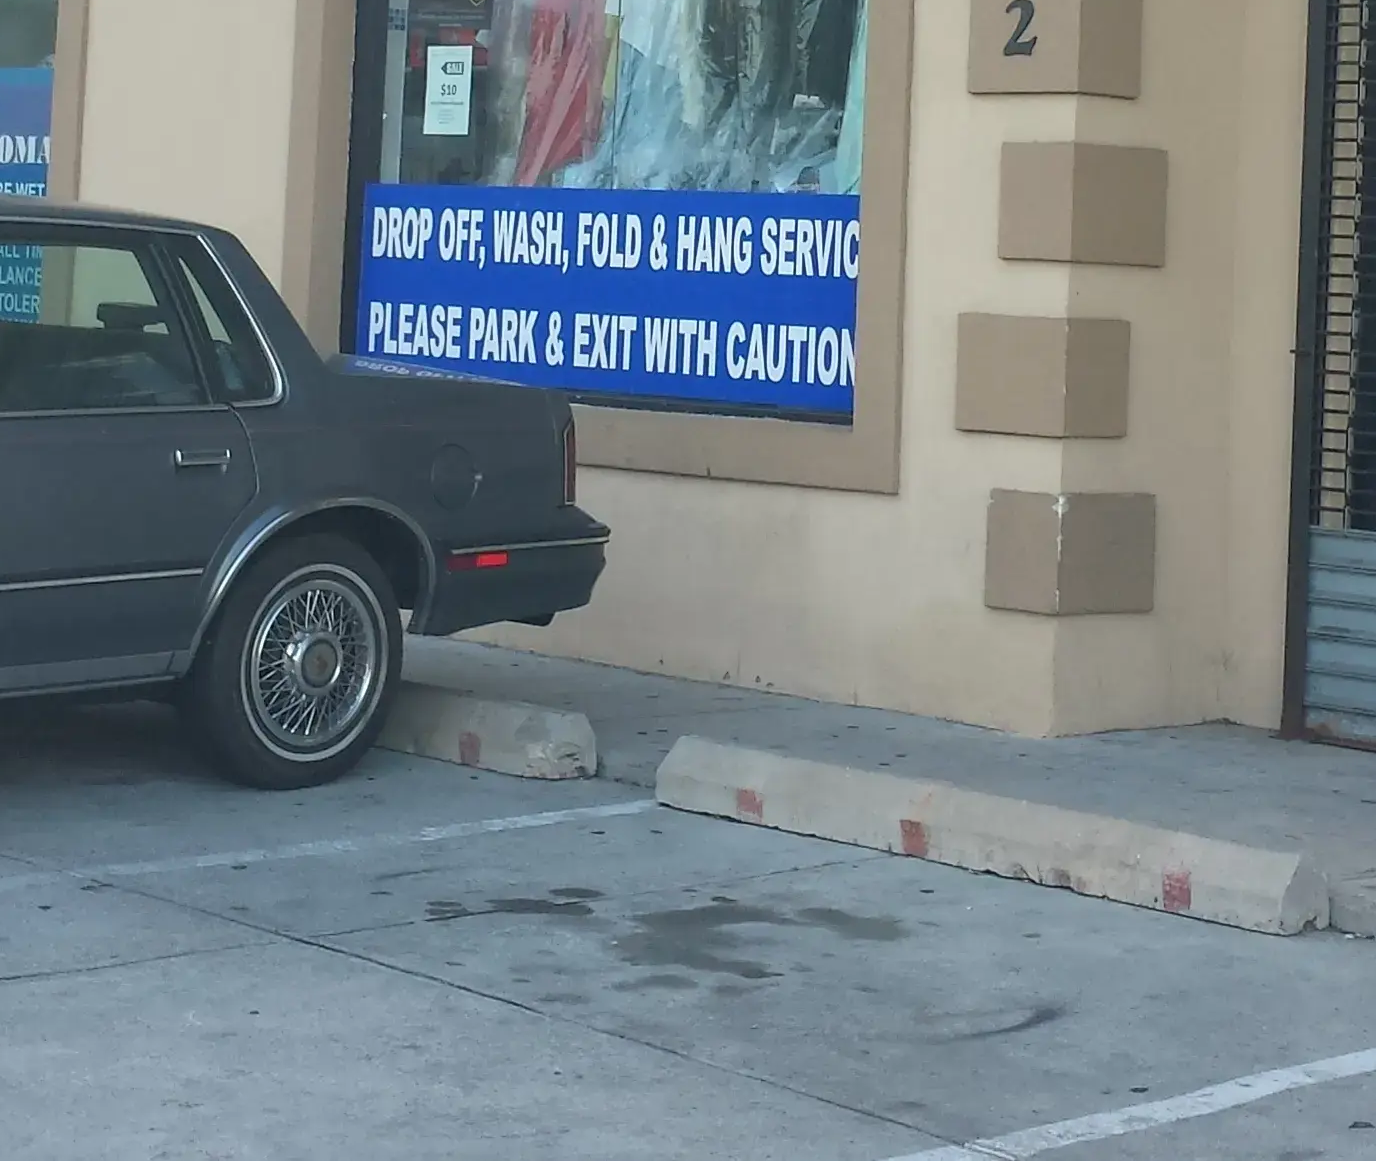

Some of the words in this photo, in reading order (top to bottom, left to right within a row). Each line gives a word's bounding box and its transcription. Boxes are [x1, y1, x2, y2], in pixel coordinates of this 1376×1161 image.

[440, 83, 458, 97] $10
[16, 183, 46, 197] WET
[371, 205, 433, 260] DROP
[438, 207, 486, 271] OFF,
[493, 209, 570, 275] WASH,
[576, 212, 642, 269] FOLD
[648, 213, 668, 271] &
[676, 215, 753, 275] HANG
[759, 217, 860, 279] SERVIC
[367, 301, 463, 359] PLEASE
[467, 306, 540, 364] PARK
[544, 310, 564, 366] &
[573, 312, 638, 371] EXIT
[643, 316, 719, 377] WITH
[725, 320, 856, 386] CAUTION
